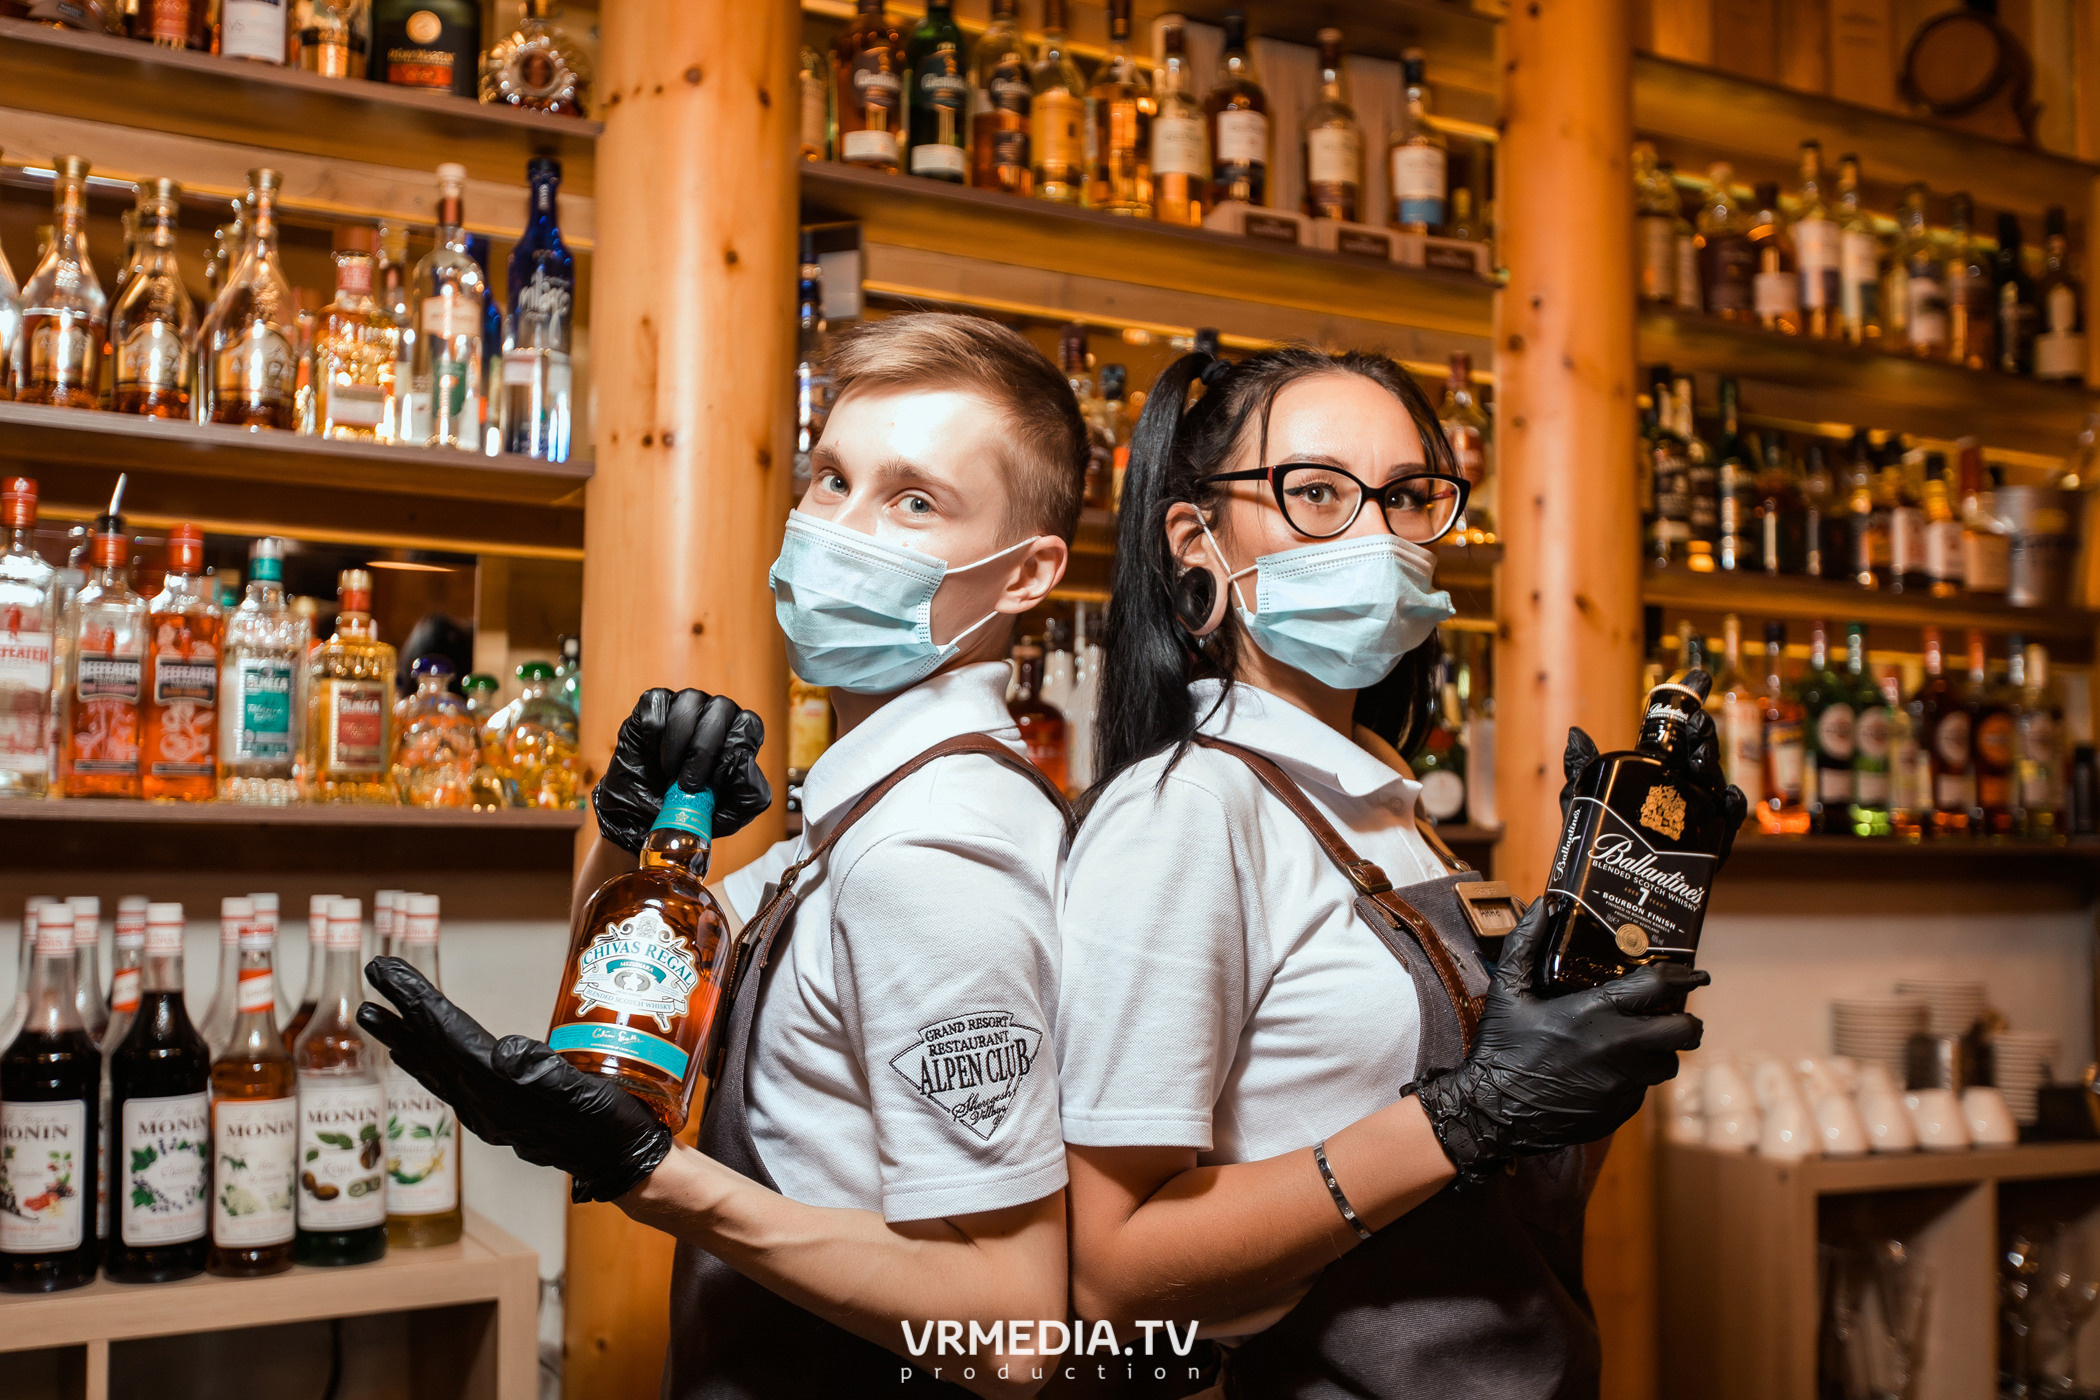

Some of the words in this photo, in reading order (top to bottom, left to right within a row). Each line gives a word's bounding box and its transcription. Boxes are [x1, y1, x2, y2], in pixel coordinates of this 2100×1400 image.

[78, 661, 141, 680] BEEFEATER
[159, 665, 216, 683] BEEFEATER
[1554, 806, 1582, 882] Ballantine's
[1588, 833, 1705, 904] Ballantine's
[1592, 859, 1631, 880] BLENDED
[1633, 876, 1665, 896] SCOTCH
[1668, 892, 1698, 912] WHISKY
[1638, 886, 1650, 907] 7
[1602, 891, 1645, 915] BOURBON
[1647, 911, 1676, 930] FINISH
[583, 941, 640, 965] CHIVAS
[644, 943, 694, 986] REGAL
[586, 988, 617, 1002] BLENDED
[615, 996, 644, 1007] SCOTCH
[646, 1001, 672, 1010] WHISKY
[925, 1021, 966, 1043] GRAND
[967, 1016, 1009, 1031] RESORT
[927, 1030, 1009, 1057] RESTAURANT
[920, 1052, 983, 1095] ALPEN
[985, 1037, 1031, 1083] CLUB
[226, 1119, 294, 1137] MONIN
[306, 1106, 378, 1123] MONIN
